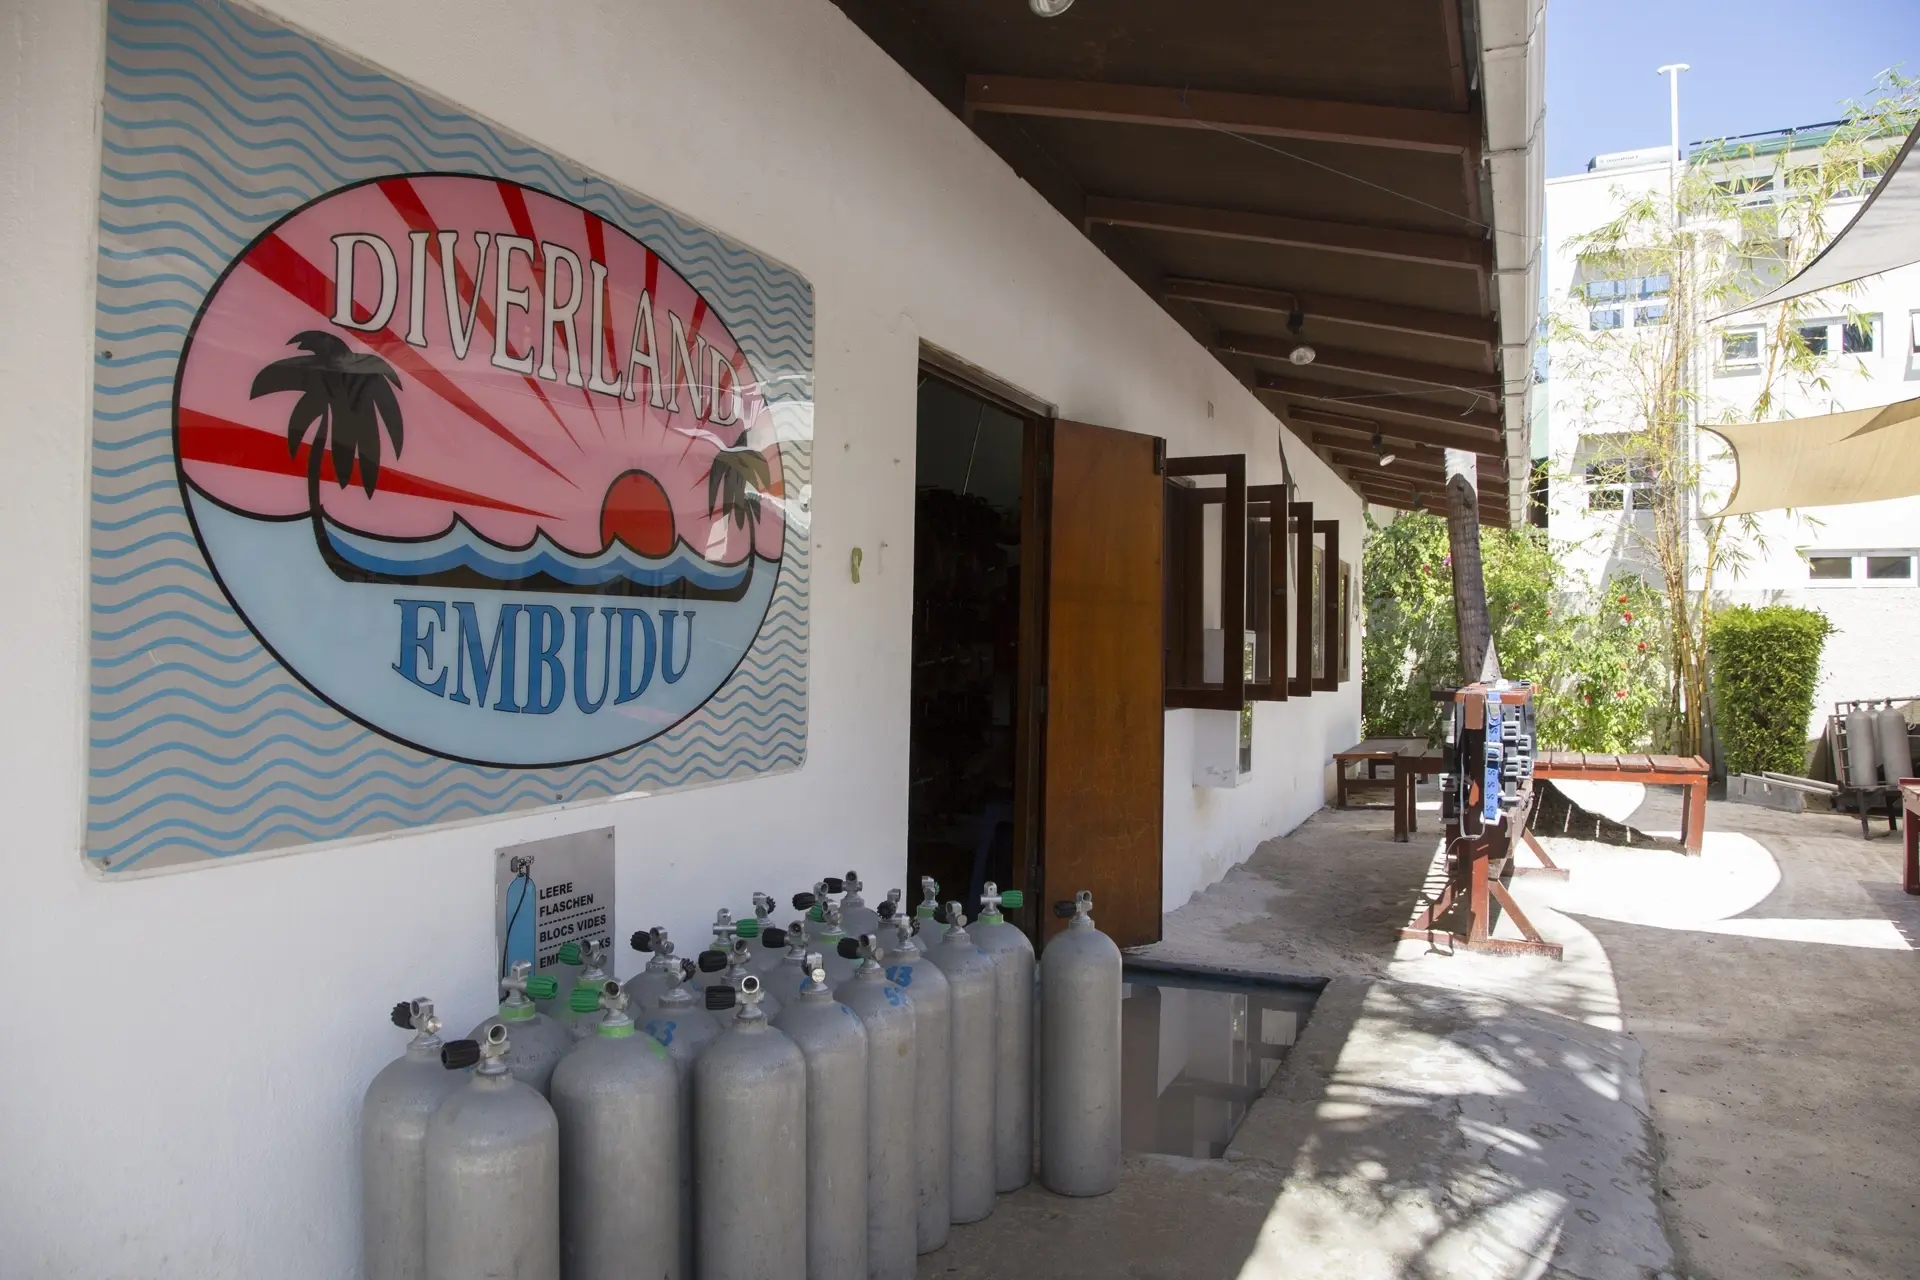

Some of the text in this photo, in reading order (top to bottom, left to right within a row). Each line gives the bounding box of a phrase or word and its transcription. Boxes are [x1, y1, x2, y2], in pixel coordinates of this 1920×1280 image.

[330, 230, 741, 427] DIVERLAND
[392, 599, 696, 714] EMBUDU
[539, 882, 573, 901] LEERE
[539, 893, 594, 918] FLASCHEN
[539, 914, 606, 943] BLOCS VIDES
